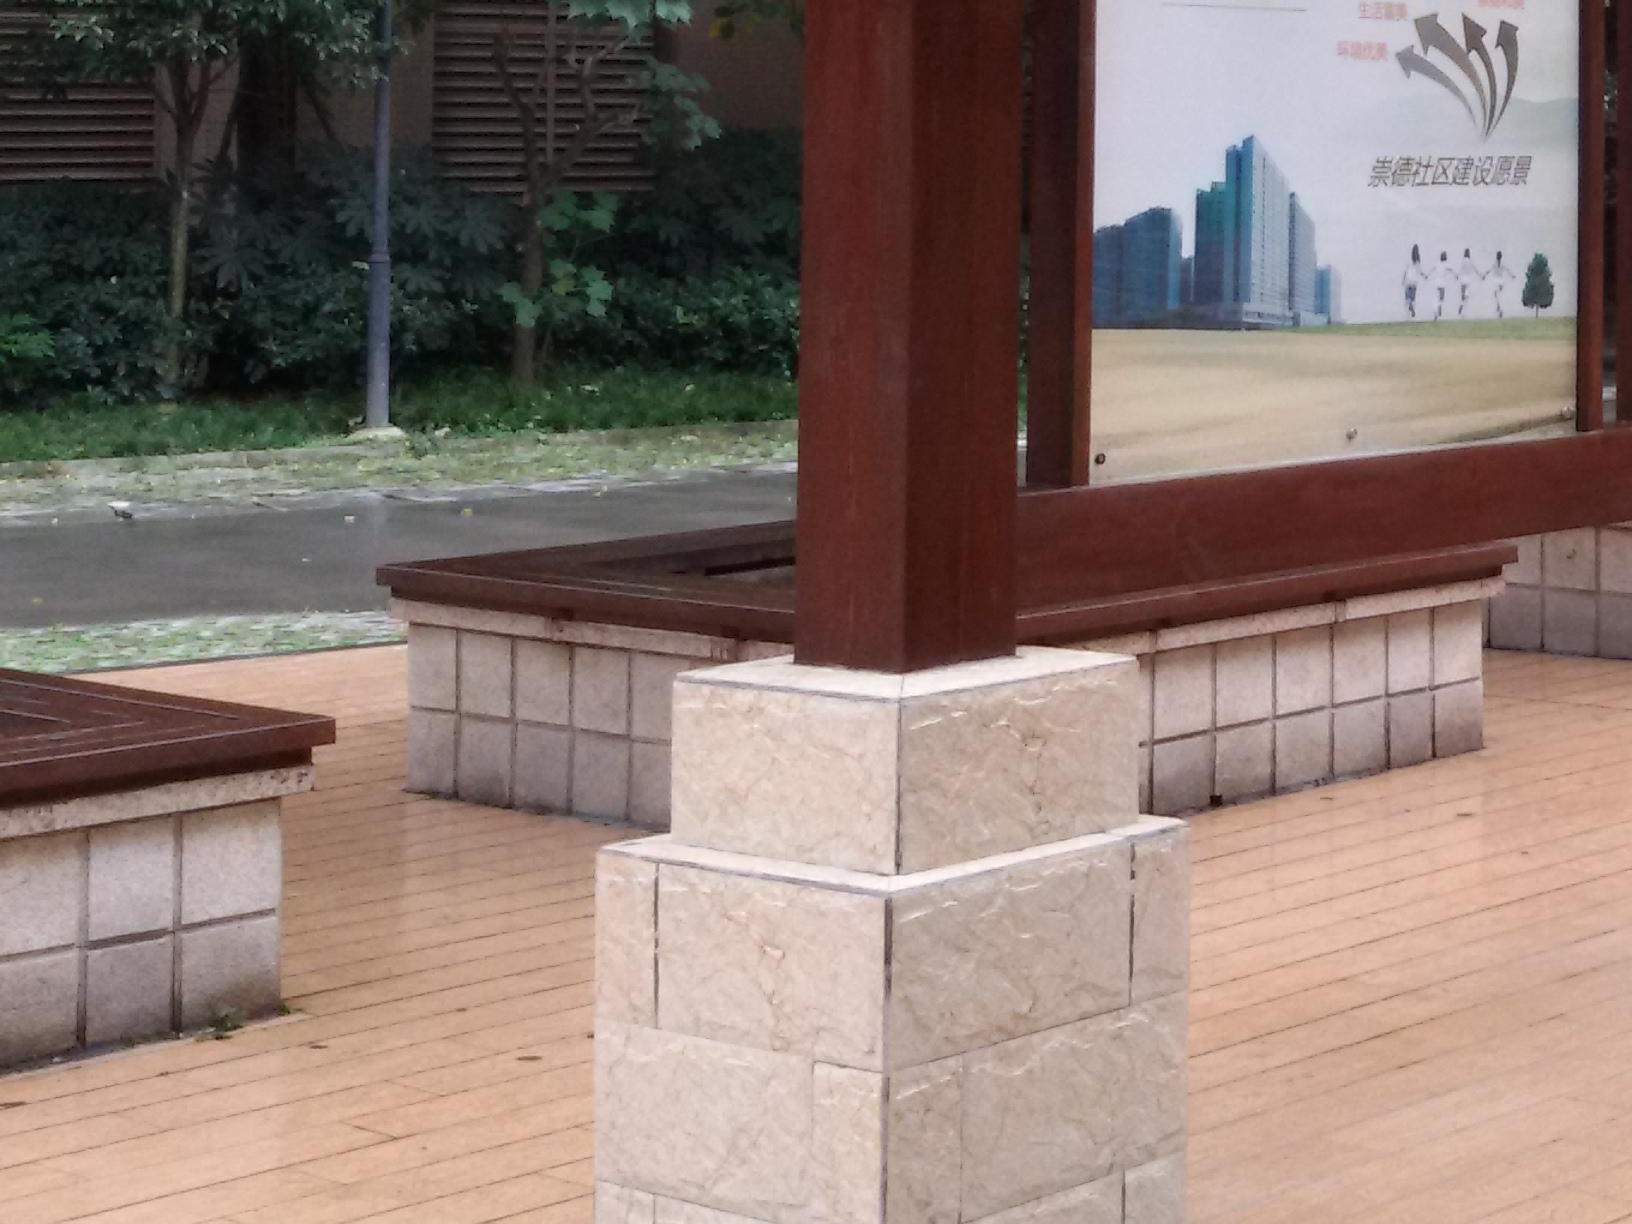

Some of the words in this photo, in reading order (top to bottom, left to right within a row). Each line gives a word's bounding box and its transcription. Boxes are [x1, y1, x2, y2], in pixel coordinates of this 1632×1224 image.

[1368, 155, 1533, 188] 崇德社区建设愿景
